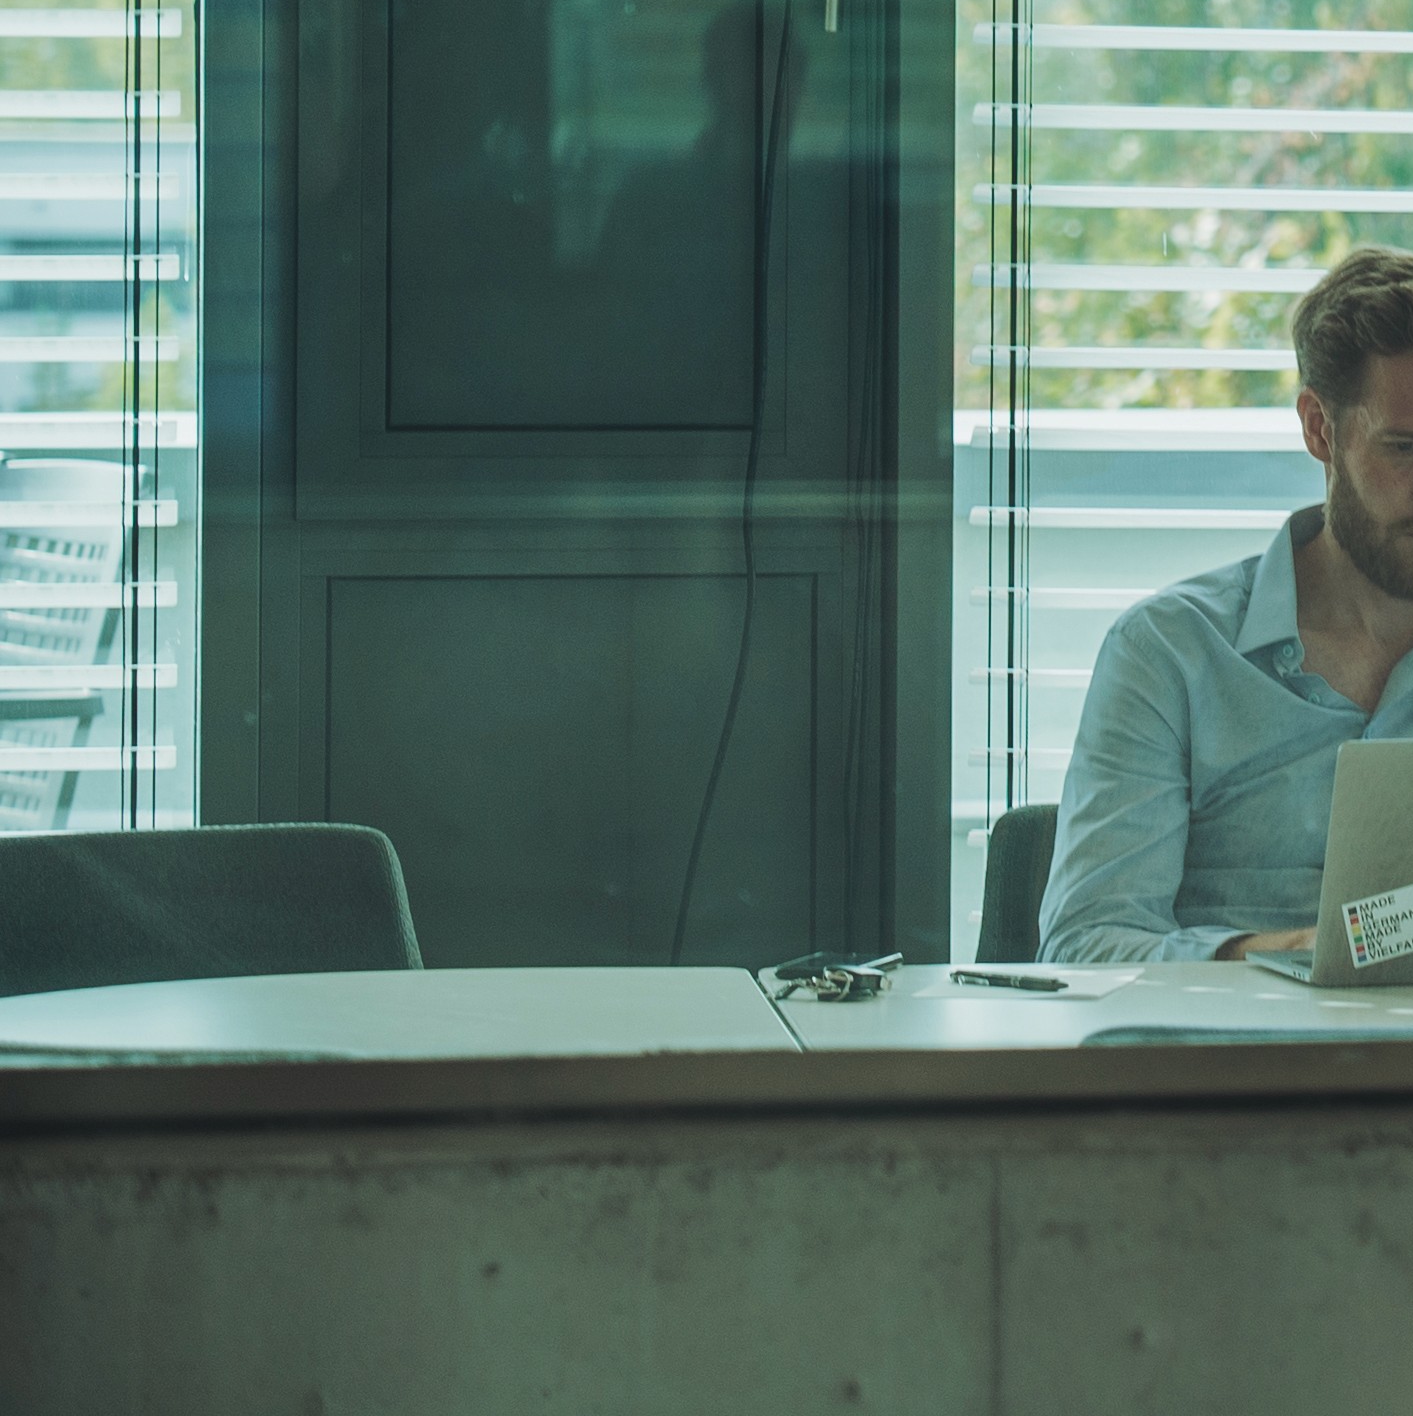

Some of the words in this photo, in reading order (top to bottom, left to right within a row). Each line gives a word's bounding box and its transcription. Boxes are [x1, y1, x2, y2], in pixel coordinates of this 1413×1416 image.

[1359, 895, 1395, 913] MADE
[1360, 910, 1374, 923] IN
[1365, 925, 1401, 941] MADE
[1367, 938, 1383, 953] BY
